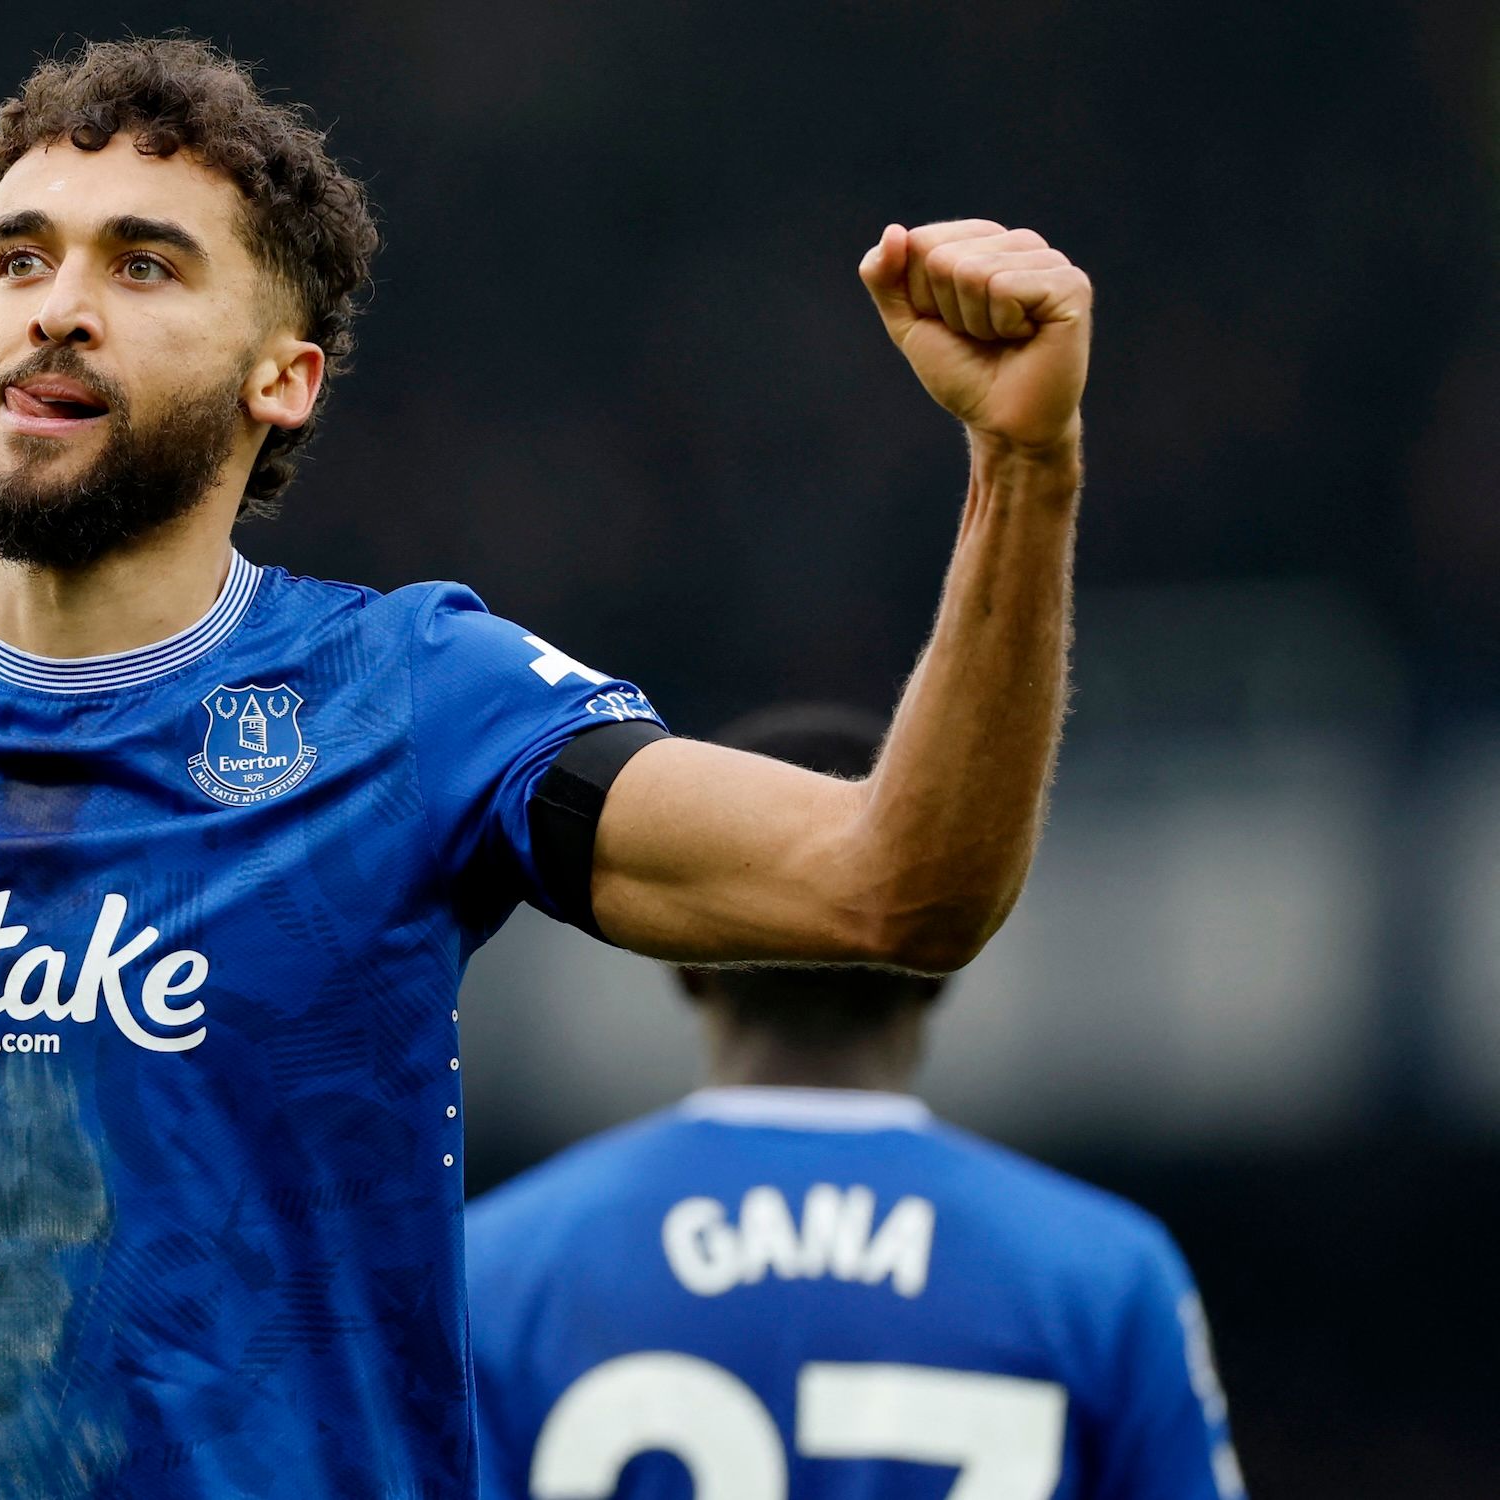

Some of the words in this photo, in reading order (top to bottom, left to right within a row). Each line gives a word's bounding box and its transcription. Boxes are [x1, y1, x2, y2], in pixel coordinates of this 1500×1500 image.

[219, 755, 288, 772] Everton
[243, 773, 264, 783] 1878
[196, 771, 210, 789] NIL
[211, 786, 240, 802] SATIS
[242, 791, 266, 803] NISI
[269, 761, 311, 796] OPTIMUM
[662, 1182, 935, 1298] GANA
